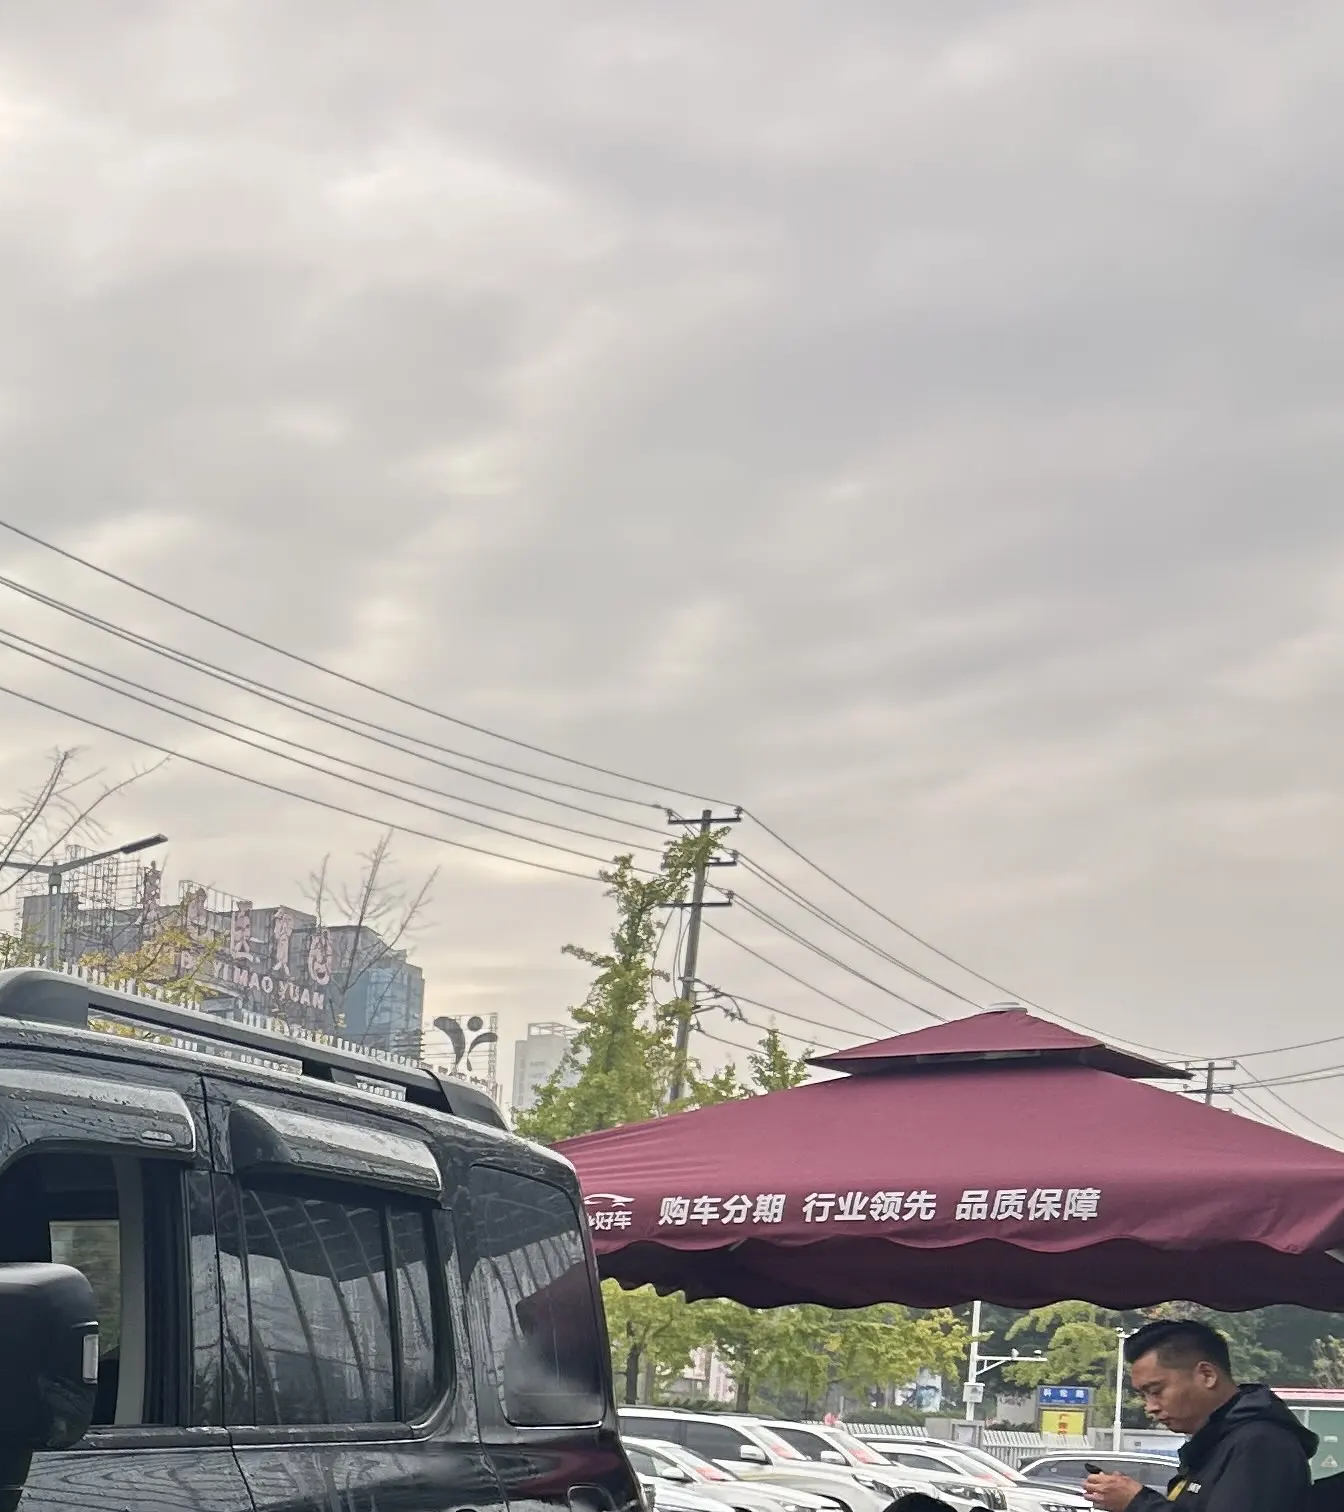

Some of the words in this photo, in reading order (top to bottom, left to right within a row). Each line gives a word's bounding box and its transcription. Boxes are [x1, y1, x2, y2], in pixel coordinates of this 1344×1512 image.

[657, 1193, 786, 1226] 购车分期
[802, 1190, 937, 1223] 行业领先
[954, 1187, 1102, 1223] 品质保障
